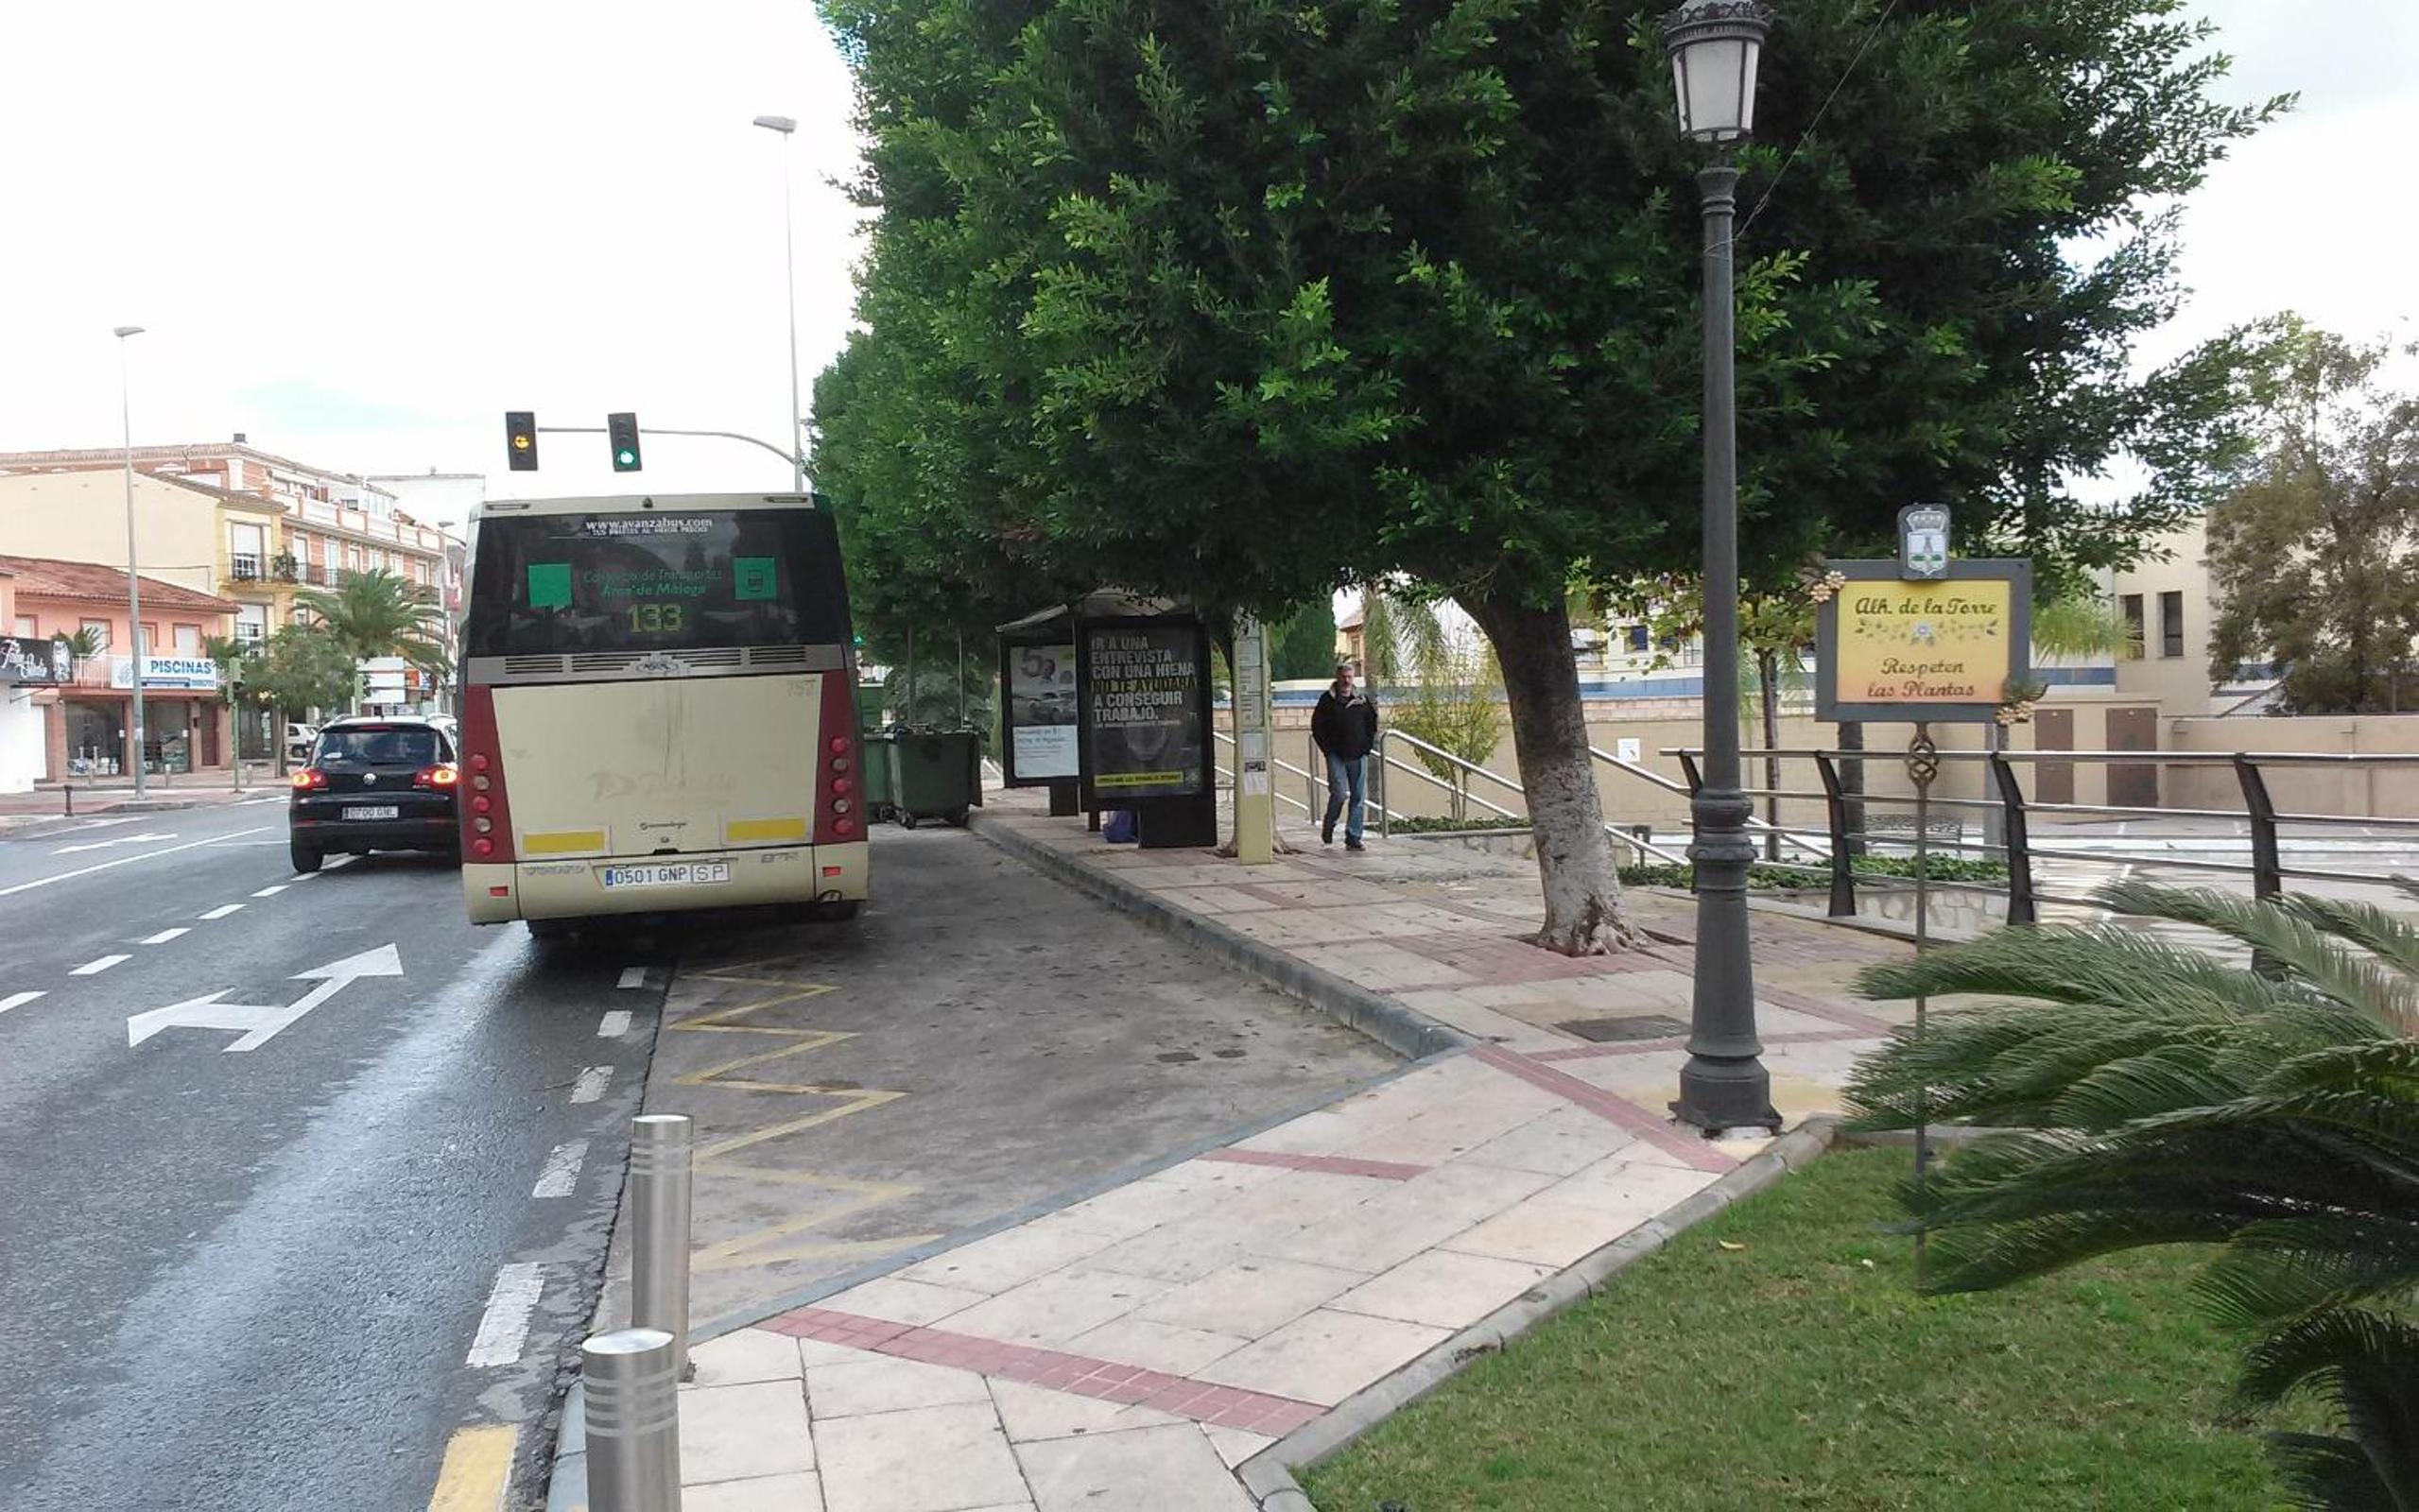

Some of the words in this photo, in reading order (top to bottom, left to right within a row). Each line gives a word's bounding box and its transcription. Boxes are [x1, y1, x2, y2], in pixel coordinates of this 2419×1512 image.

[586, 517, 712, 530] www.avanzabus.com
[1899, 597, 1920, 614] de
[1924, 597, 1944, 614] la
[1945, 597, 1996, 614] Torre
[628, 603, 682, 633] 133
[1092, 637, 1104, 650] IR
[1108, 637, 1116, 650] A
[1121, 636, 1149, 650] UNA
[1092, 649, 1172, 664] ENTREVISTA
[151, 660, 213, 675] PISCINAS
[1092, 664, 1120, 679] CON
[1124, 663, 1152, 679] UNA
[1155, 662, 1196, 678] HIENA
[1880, 658, 1964, 678] Respeten
[1868, 681, 1896, 697] las
[1901, 679, 1975, 697] Plantas
[1095, 694, 1104, 708] A
[1106, 691, 1183, 708] CONSEGUIR
[614, 869, 652, 885] 0501
[658, 866, 687, 882] GNP
